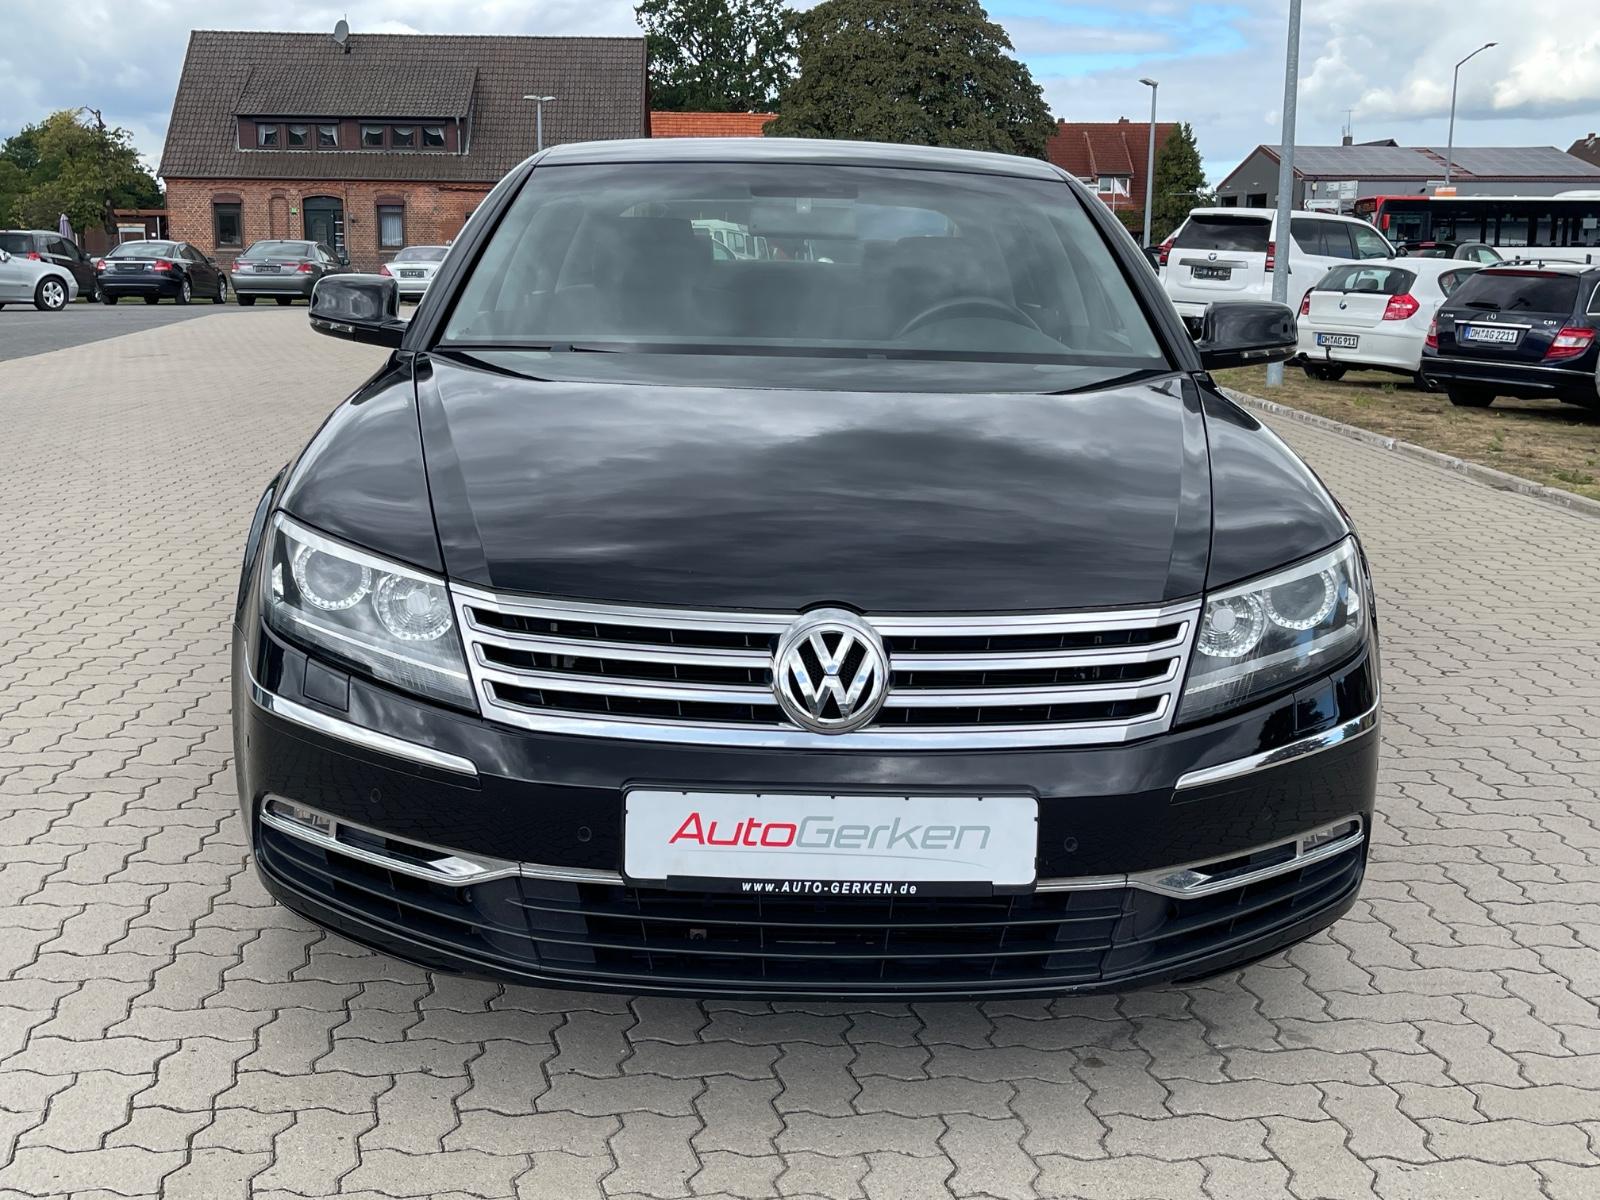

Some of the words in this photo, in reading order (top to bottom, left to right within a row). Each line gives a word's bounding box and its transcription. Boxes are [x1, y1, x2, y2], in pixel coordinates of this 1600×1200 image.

[1343, 336, 1356, 346] 911
[1495, 330, 1515, 342] 2211
[741, 880, 918, 896] www.AUTO-GERKEN.de
